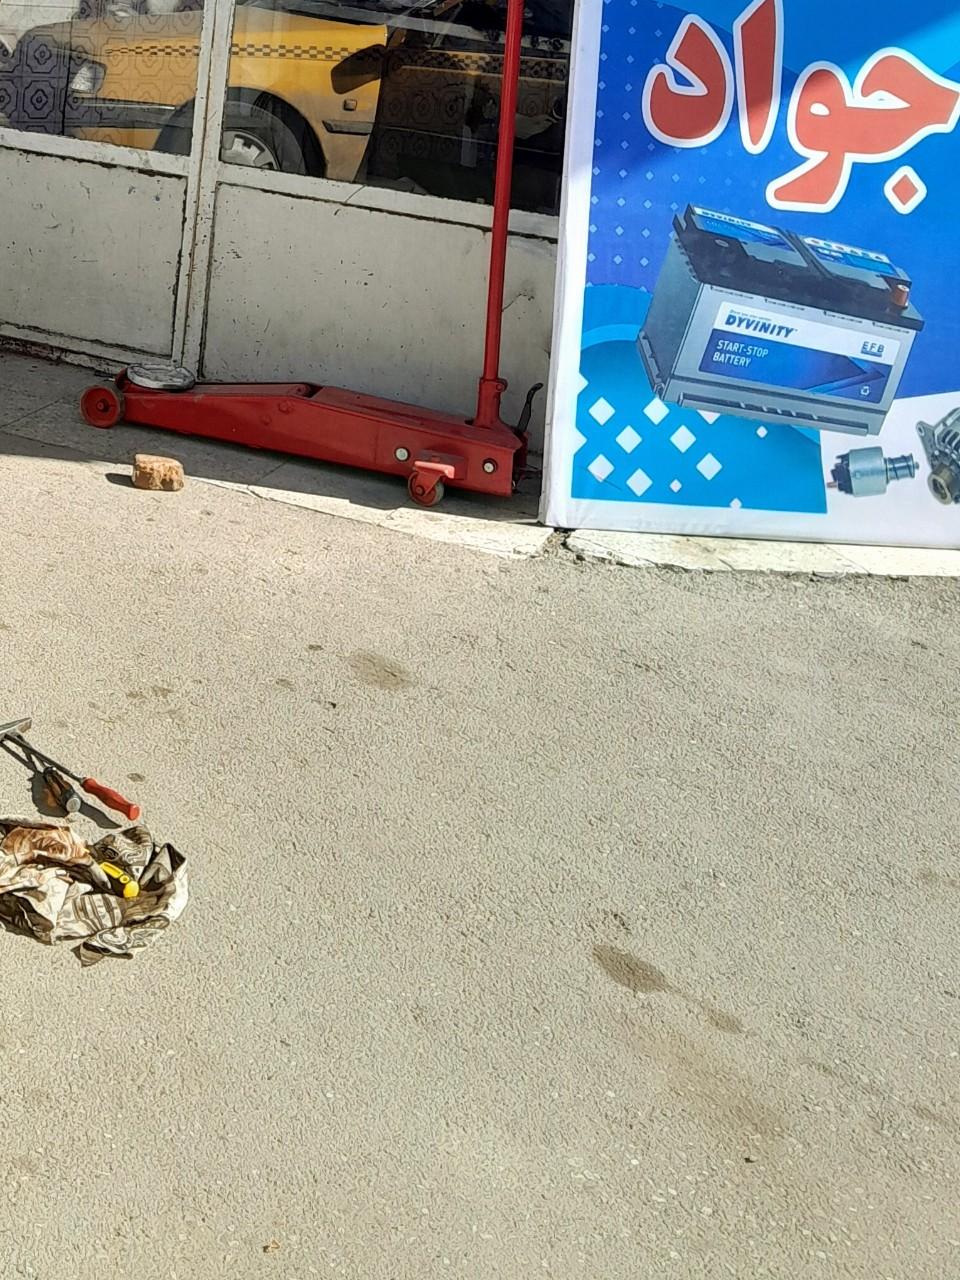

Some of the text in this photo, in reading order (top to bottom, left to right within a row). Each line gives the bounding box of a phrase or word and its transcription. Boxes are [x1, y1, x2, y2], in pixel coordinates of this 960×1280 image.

[724, 314, 795, 339] DYVINITY
[716, 339, 769, 357] START-STOP
[861, 341, 885, 355] EFB
[712, 351, 752, 368] BATTERY
